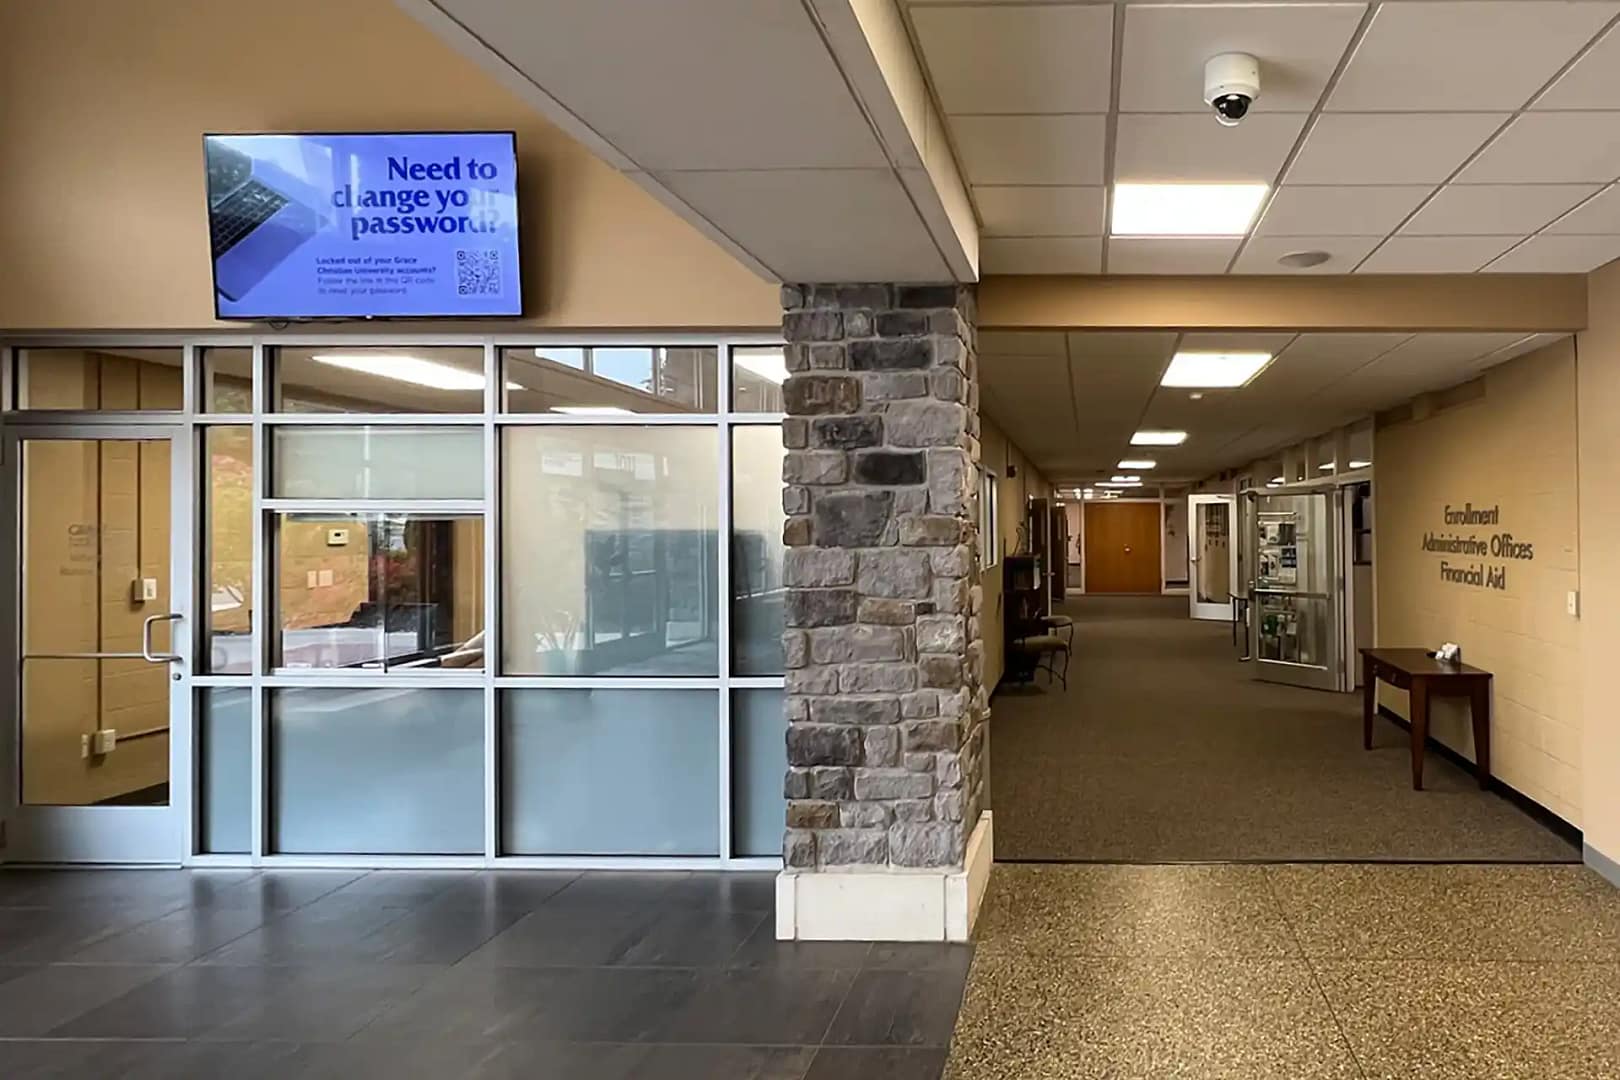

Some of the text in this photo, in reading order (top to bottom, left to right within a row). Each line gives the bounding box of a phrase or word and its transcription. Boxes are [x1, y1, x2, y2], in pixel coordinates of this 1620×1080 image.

[387, 156, 498, 181] Need to
[332, 184, 430, 214] change
[351, 210, 500, 240] password?
[354, 267, 394, 275] University
[363, 256, 372, 264] of
[375, 258, 392, 266] your
[394, 256, 417, 264] Grace
[1444, 503, 1499, 525] Enrollment
[1422, 532, 1533, 560] Administrative Offices
[1441, 561, 1505, 590] Financial Aid
